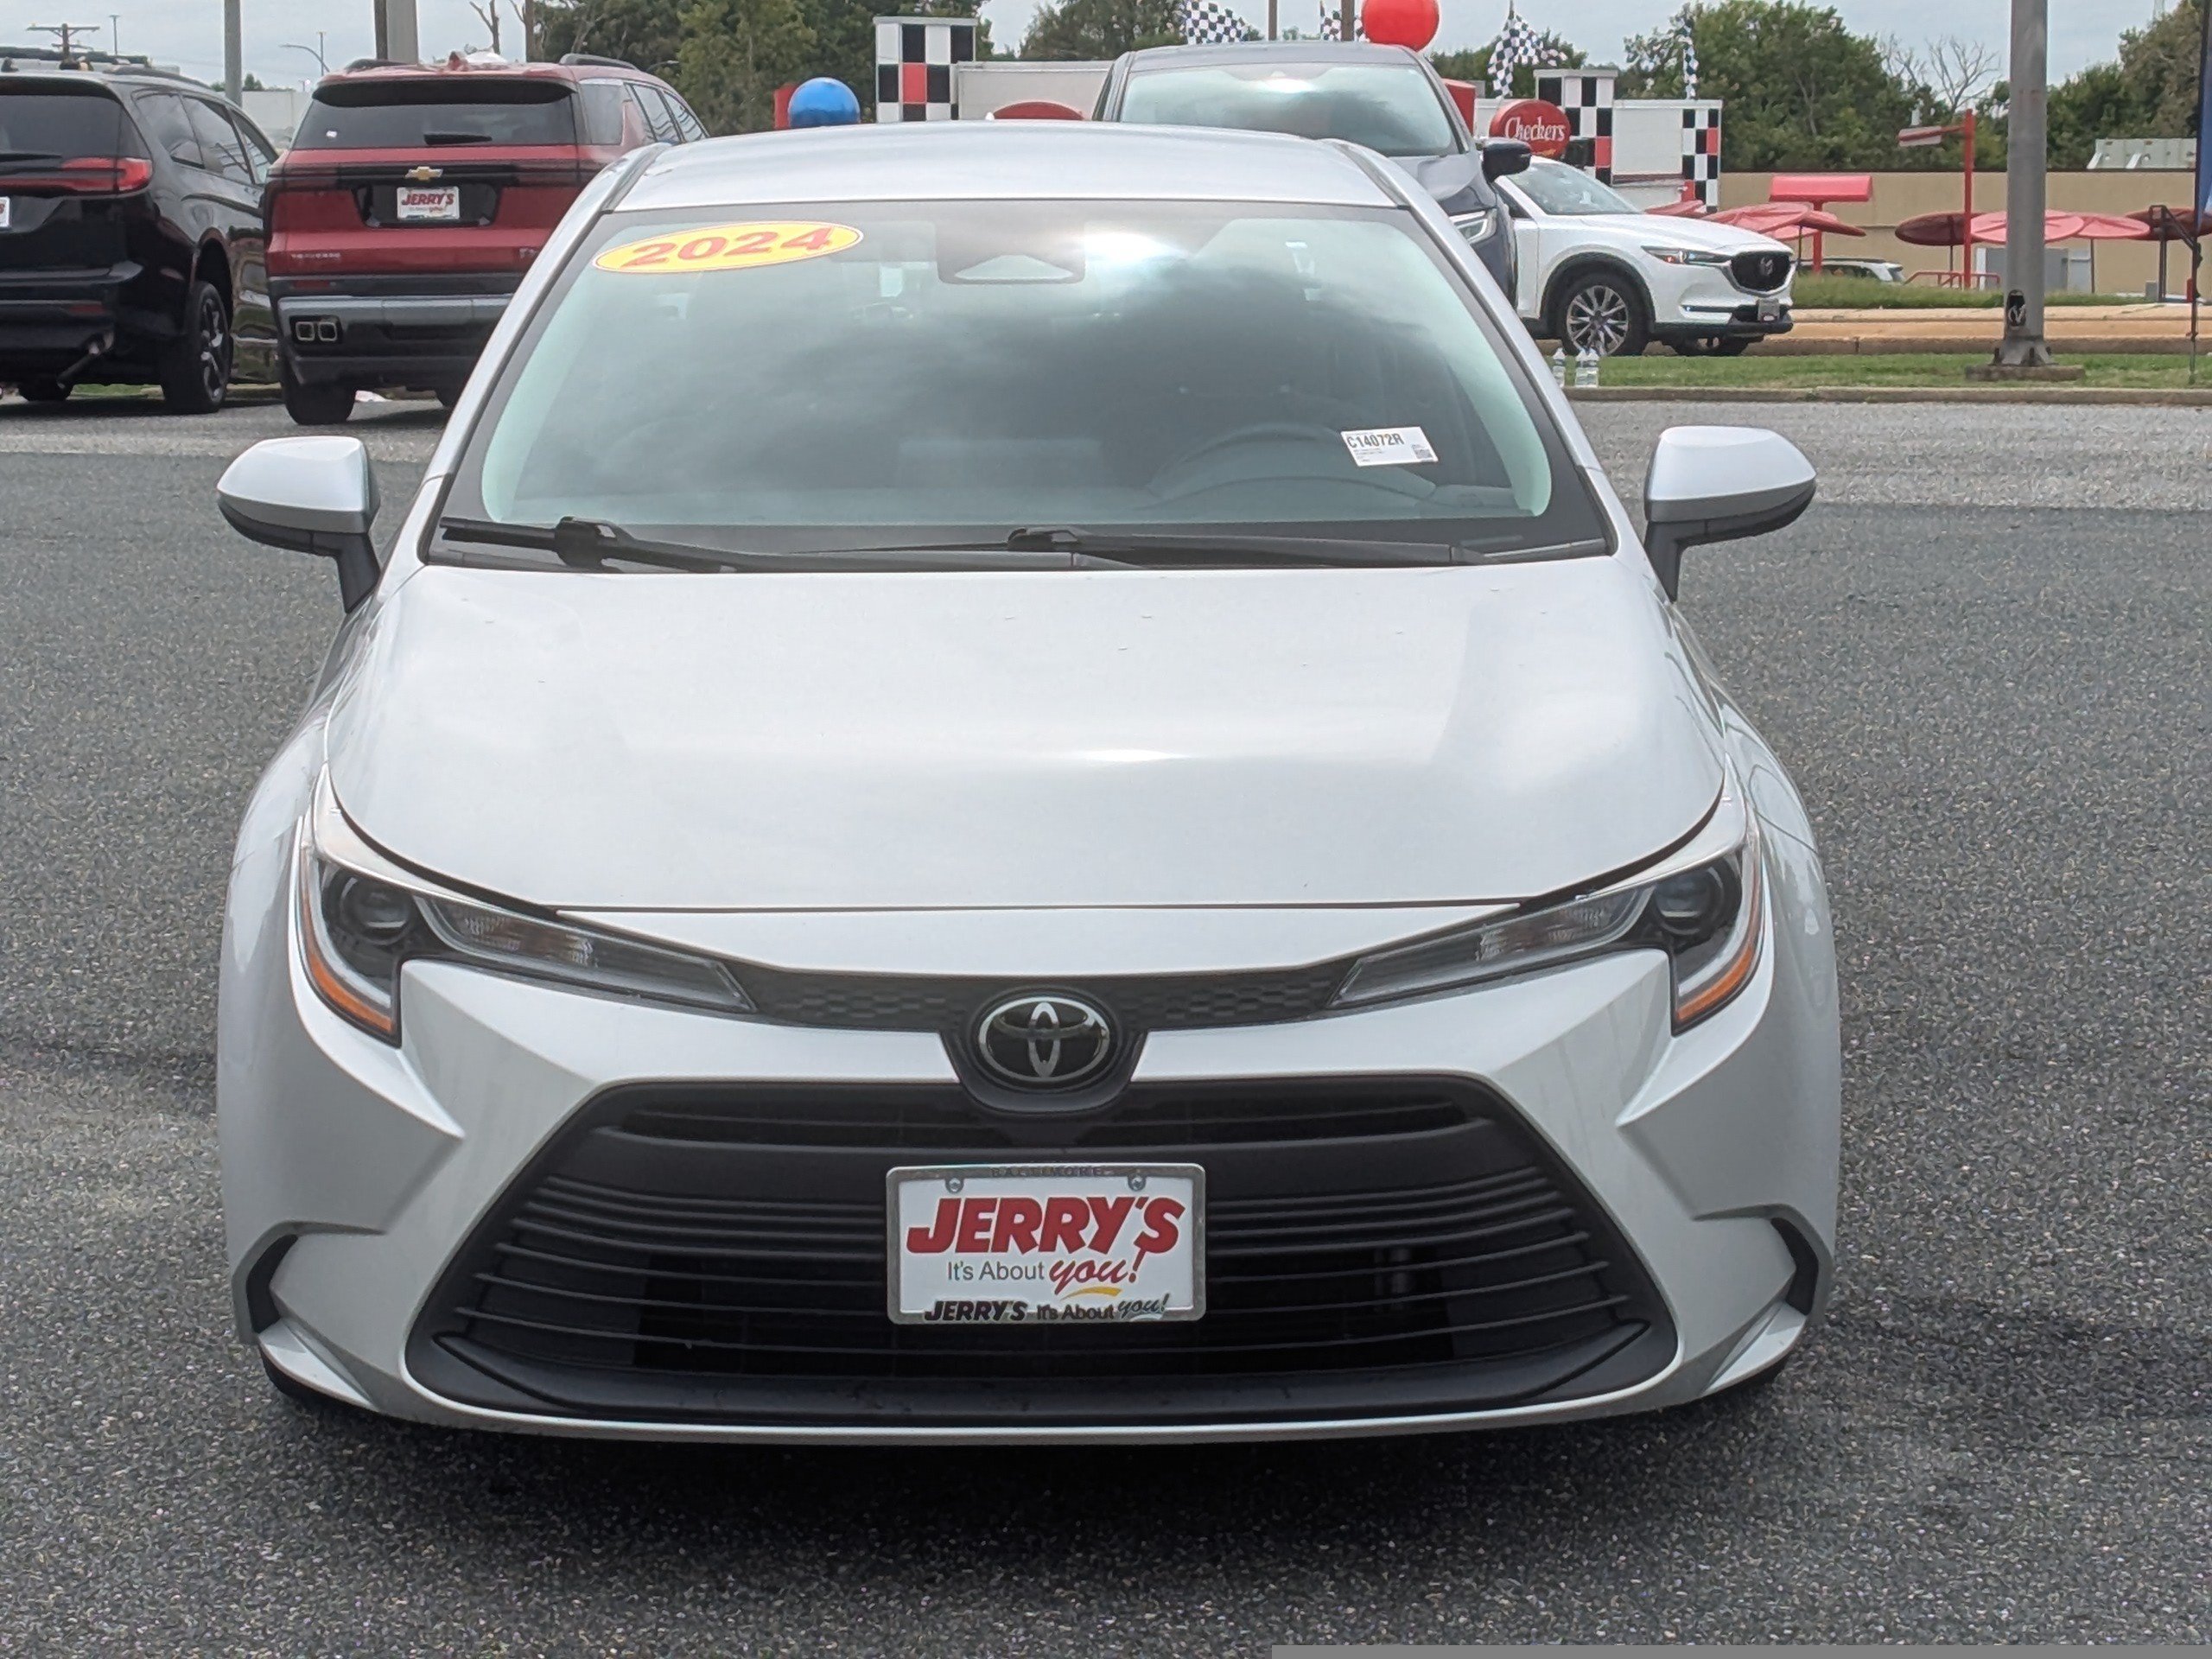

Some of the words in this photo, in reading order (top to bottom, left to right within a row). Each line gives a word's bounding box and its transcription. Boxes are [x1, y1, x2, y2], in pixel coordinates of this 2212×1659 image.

[1504, 116, 1566, 142] Checkers
[401, 194, 454, 206] JERRY'S
[620, 226, 836, 269] 2024
[1347, 433, 1405, 448] C14072R
[906, 1197, 1186, 1255] JERRY'S
[948, 1262, 974, 1281] It's
[979, 1261, 1045, 1281] About
[1049, 1249, 1147, 1295] you!
[925, 1300, 1028, 1321] JERRY'S
[1037, 1305, 1058, 1320] It's
[1062, 1304, 1114, 1320] About
[1118, 1293, 1170, 1319] you!
